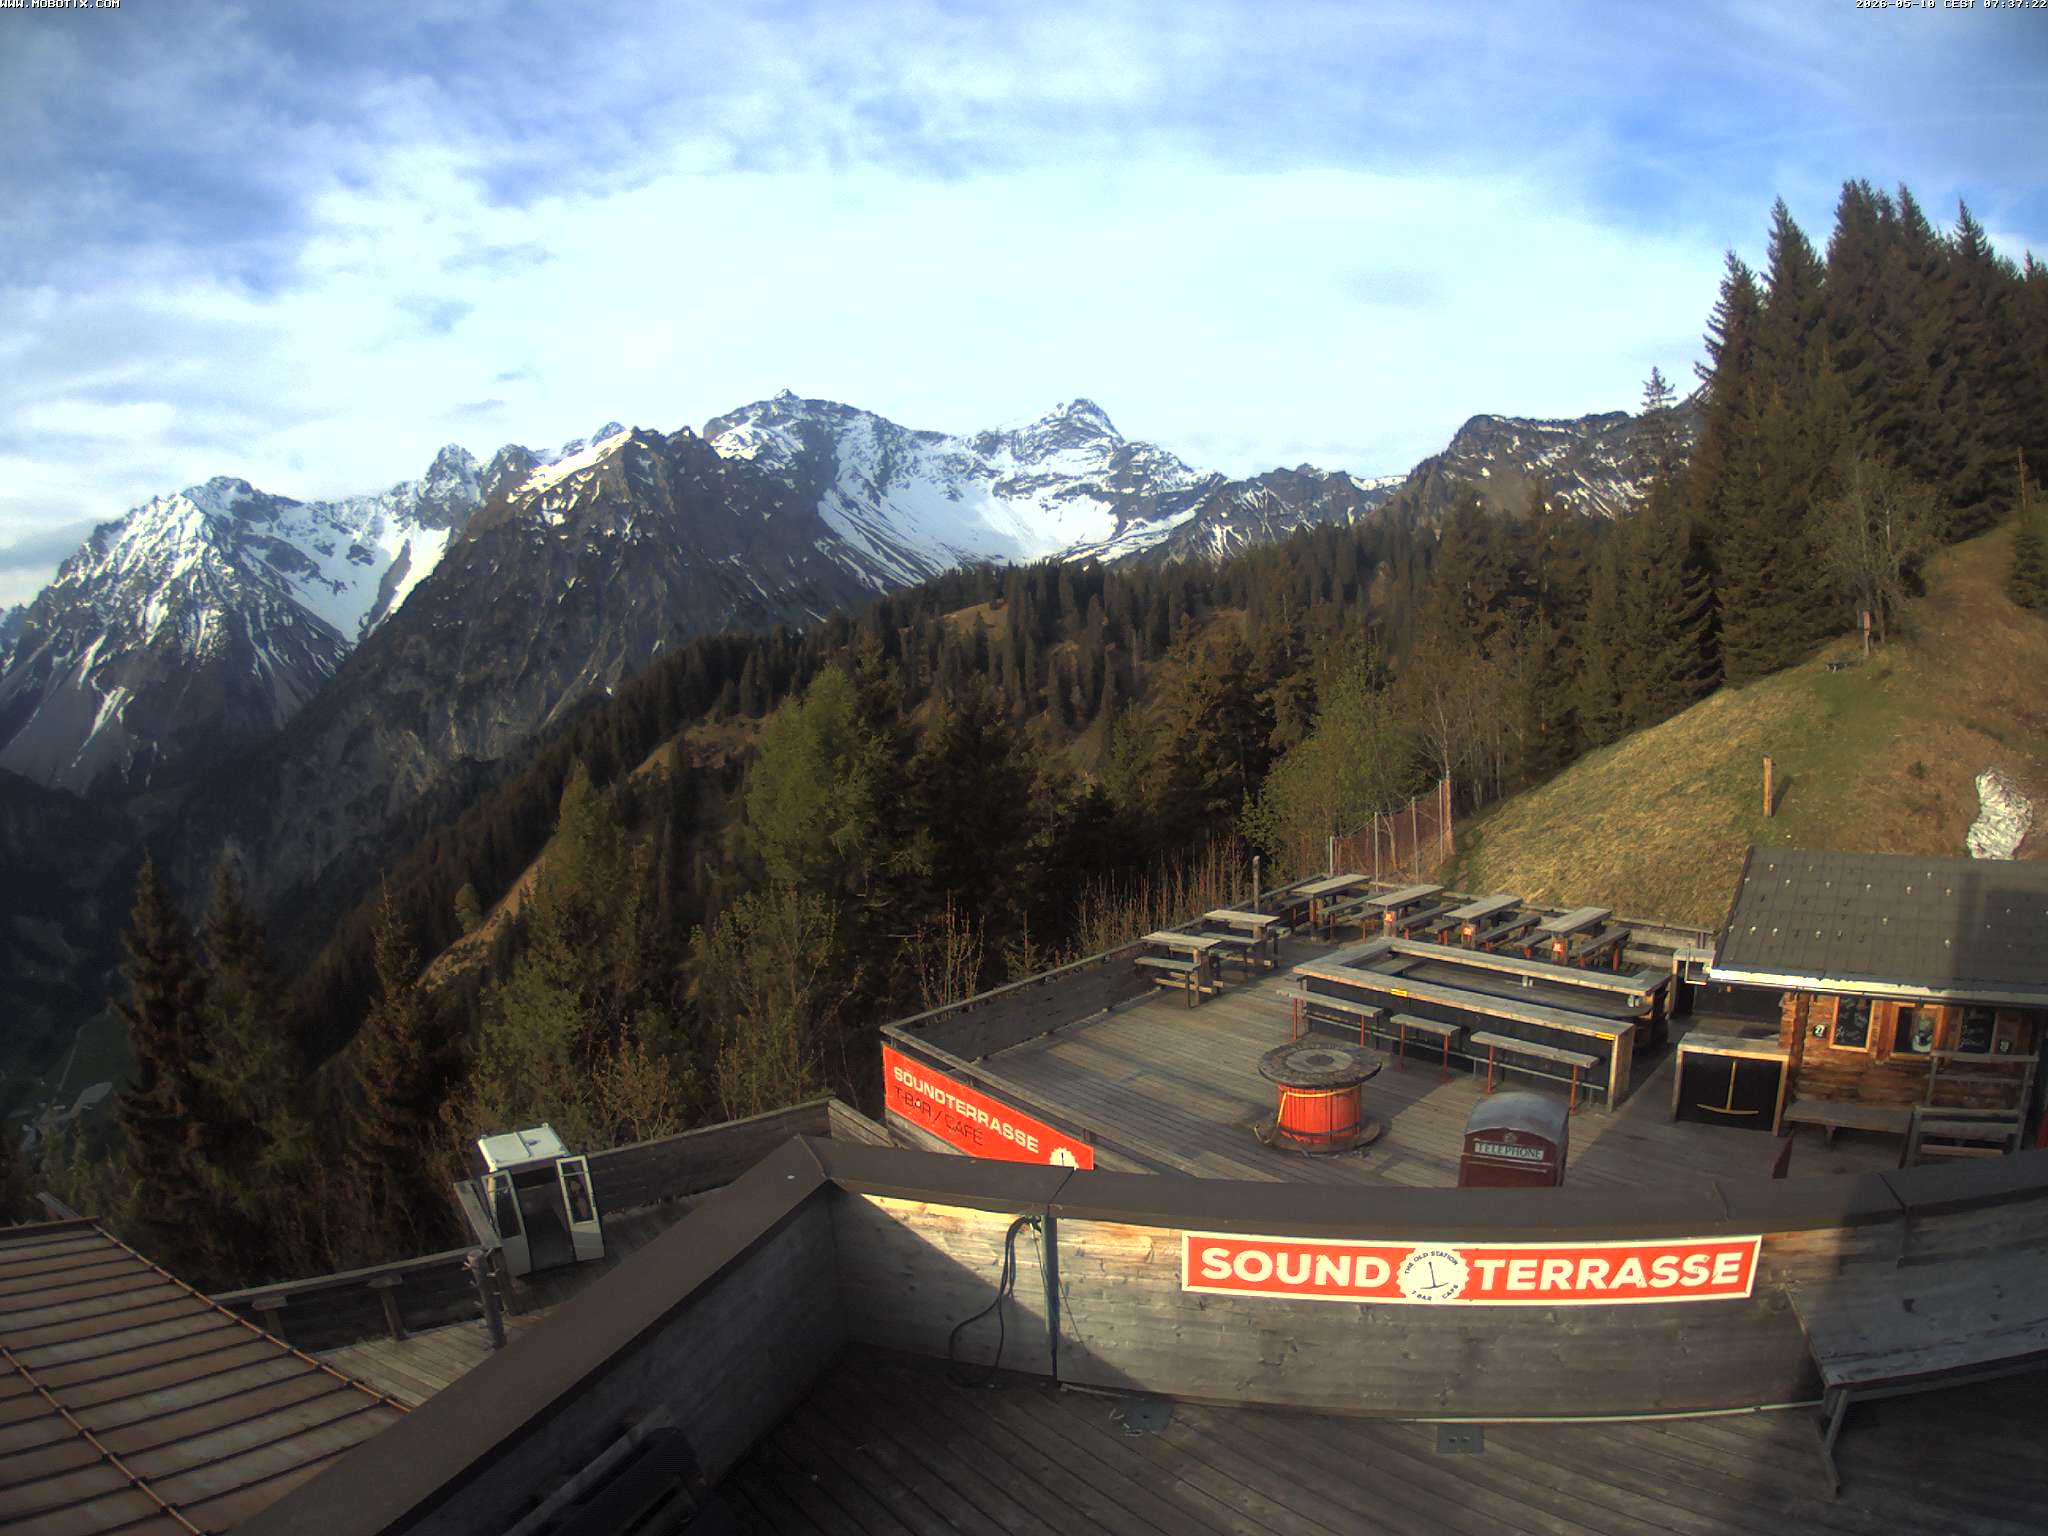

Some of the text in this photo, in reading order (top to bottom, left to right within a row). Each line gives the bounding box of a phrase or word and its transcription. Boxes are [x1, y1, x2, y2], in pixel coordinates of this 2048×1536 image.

[893, 1066, 1039, 1154] SOUNDTERRASSE
[1475, 1142, 1543, 1160] TELEPHONE
[1201, 1247, 1744, 1290] SOUND TERRASSE
[1413, 1252, 1428, 1262] OLD
[1430, 1251, 1458, 1265] STATION
